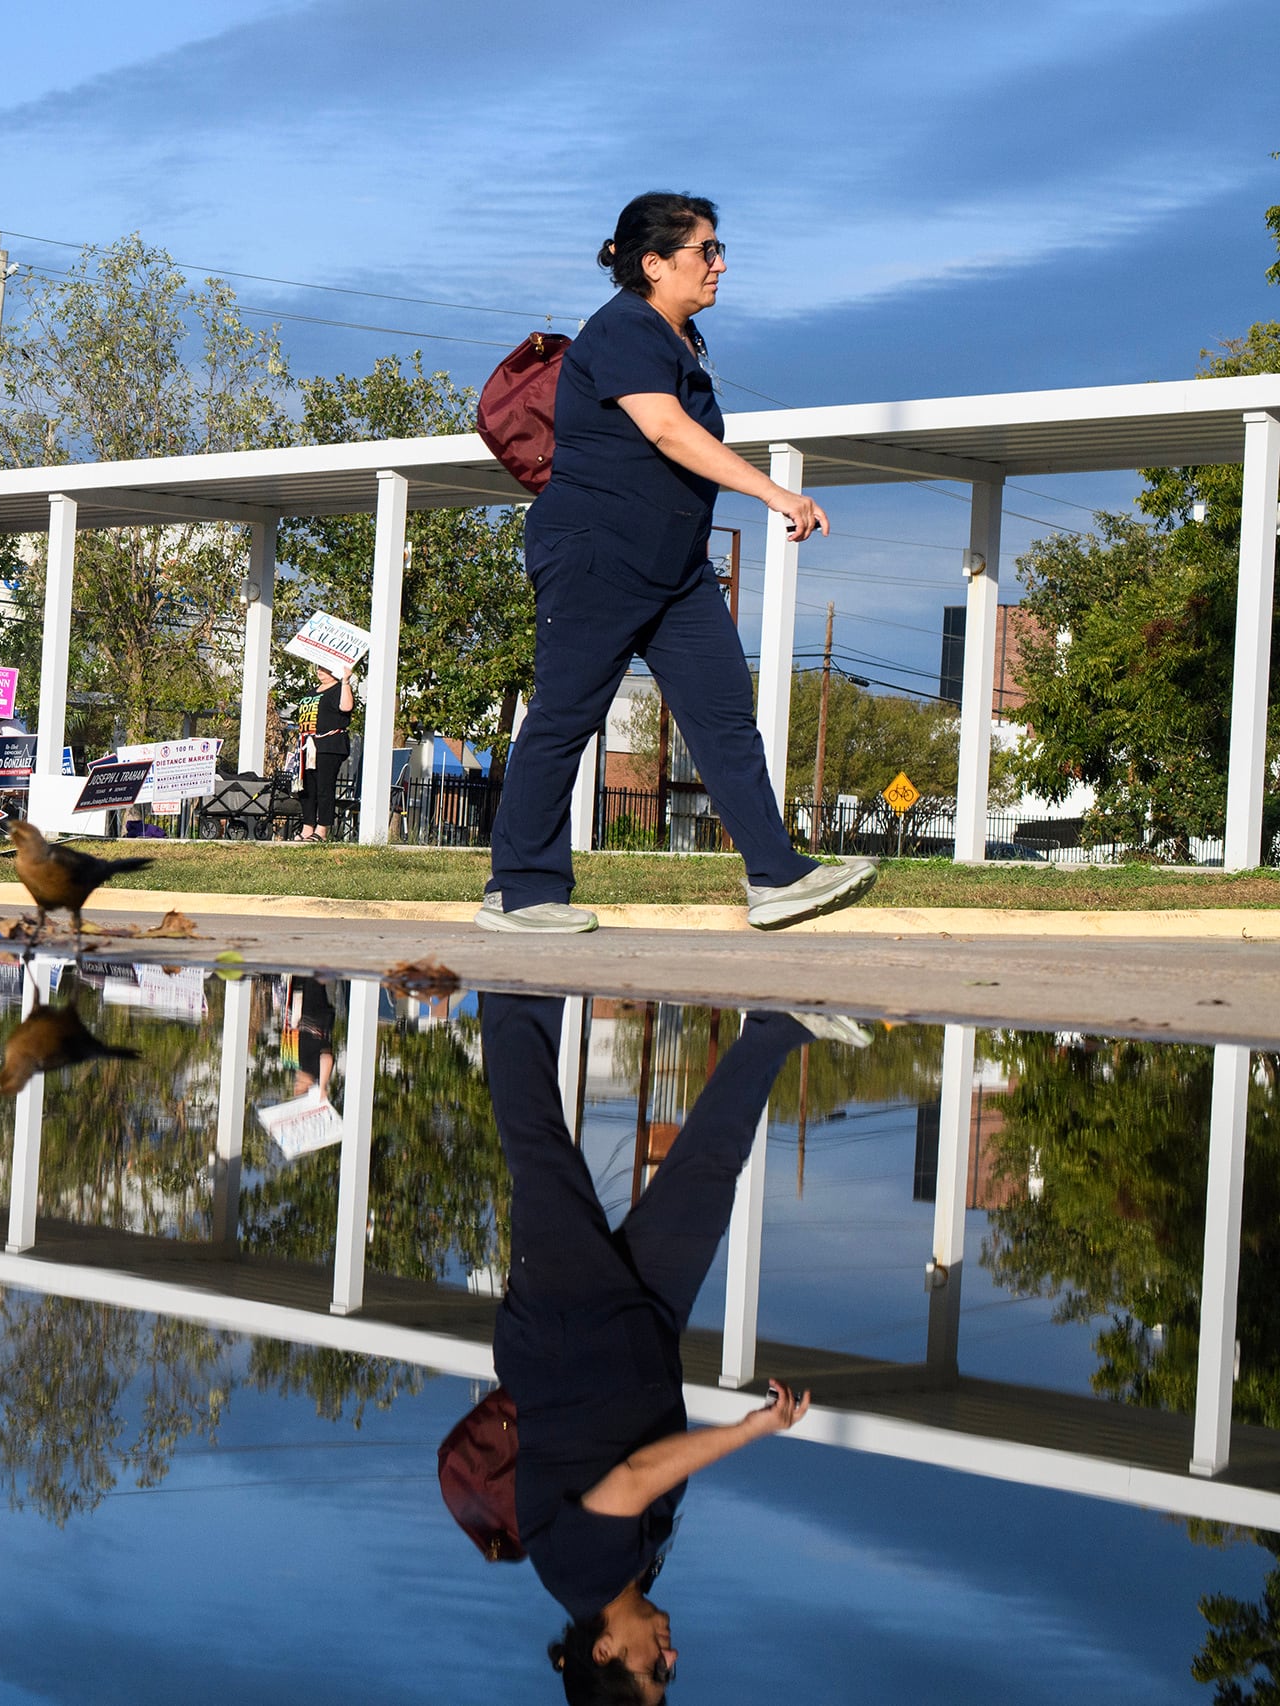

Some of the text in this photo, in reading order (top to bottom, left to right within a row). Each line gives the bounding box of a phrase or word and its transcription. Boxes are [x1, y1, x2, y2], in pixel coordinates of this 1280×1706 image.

[3, 757, 32, 769] GONZALEZ
[156, 754, 214, 767] DISTANCE MARKER
[88, 772, 116, 786] JOSEPH
[120, 769, 147, 782] TRAHAN
